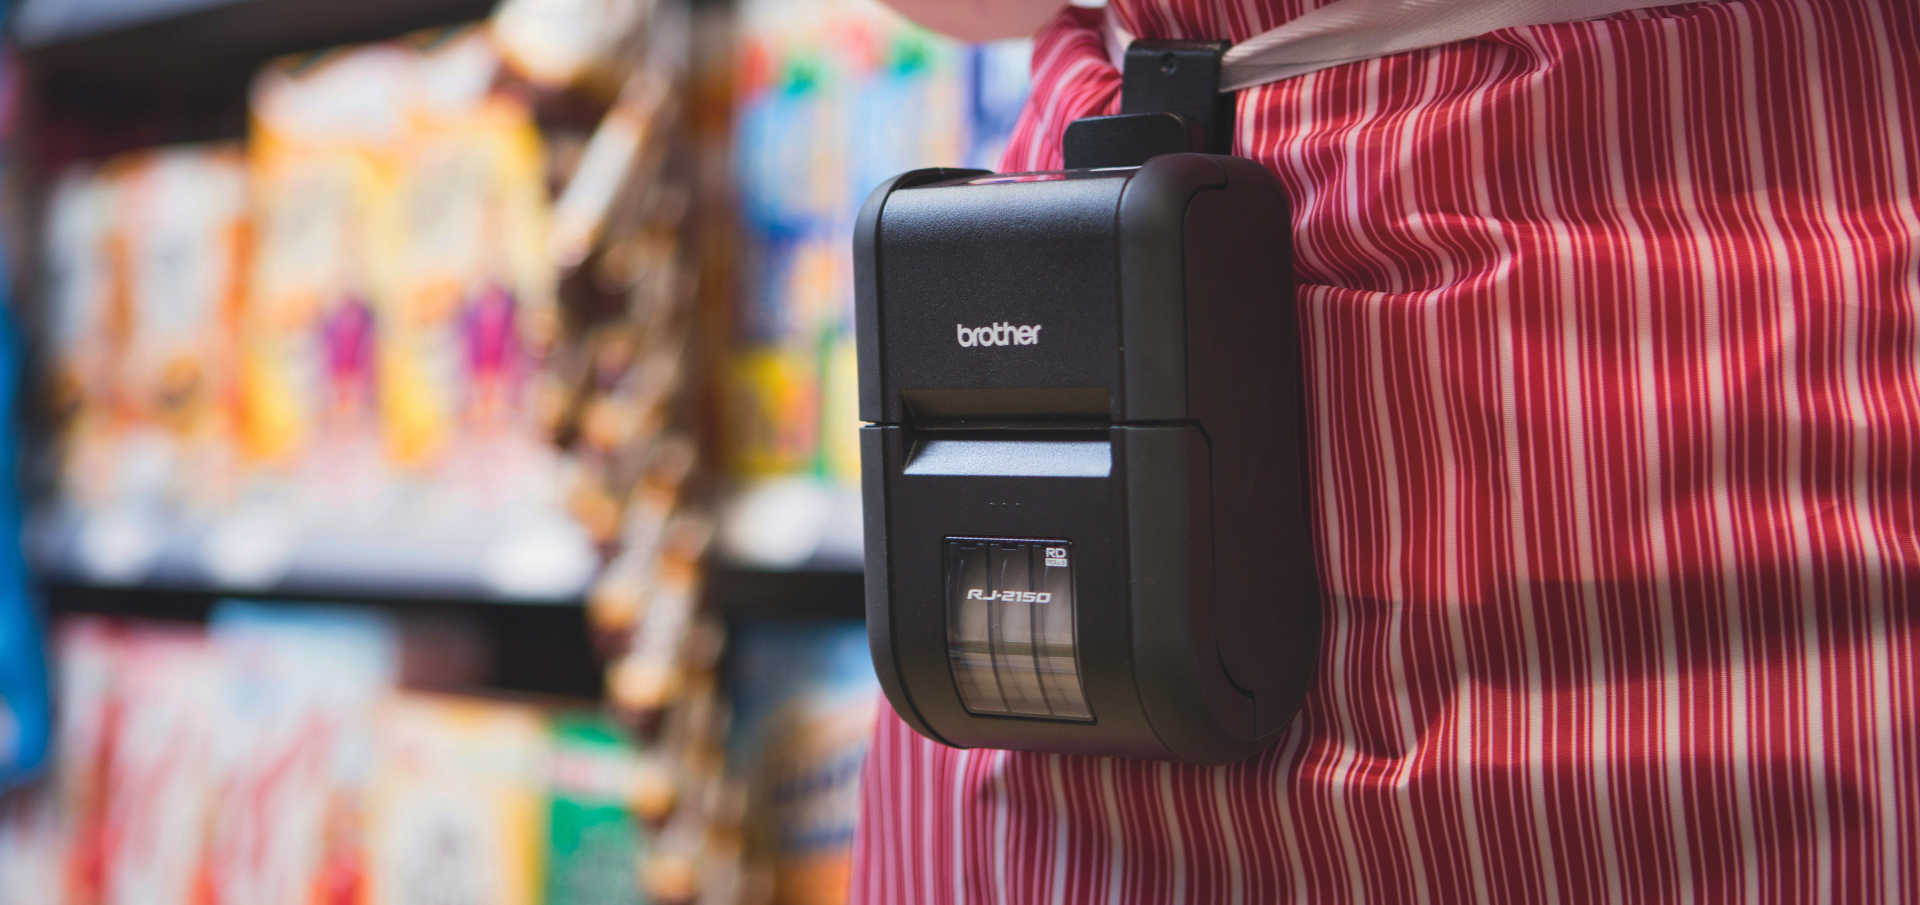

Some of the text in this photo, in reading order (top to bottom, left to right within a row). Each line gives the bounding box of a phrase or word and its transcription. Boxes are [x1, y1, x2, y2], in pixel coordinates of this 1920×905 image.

[957, 322, 1042, 348] brother
[1046, 547, 1067, 558] RD
[966, 588, 1052, 604] RJ-2150
